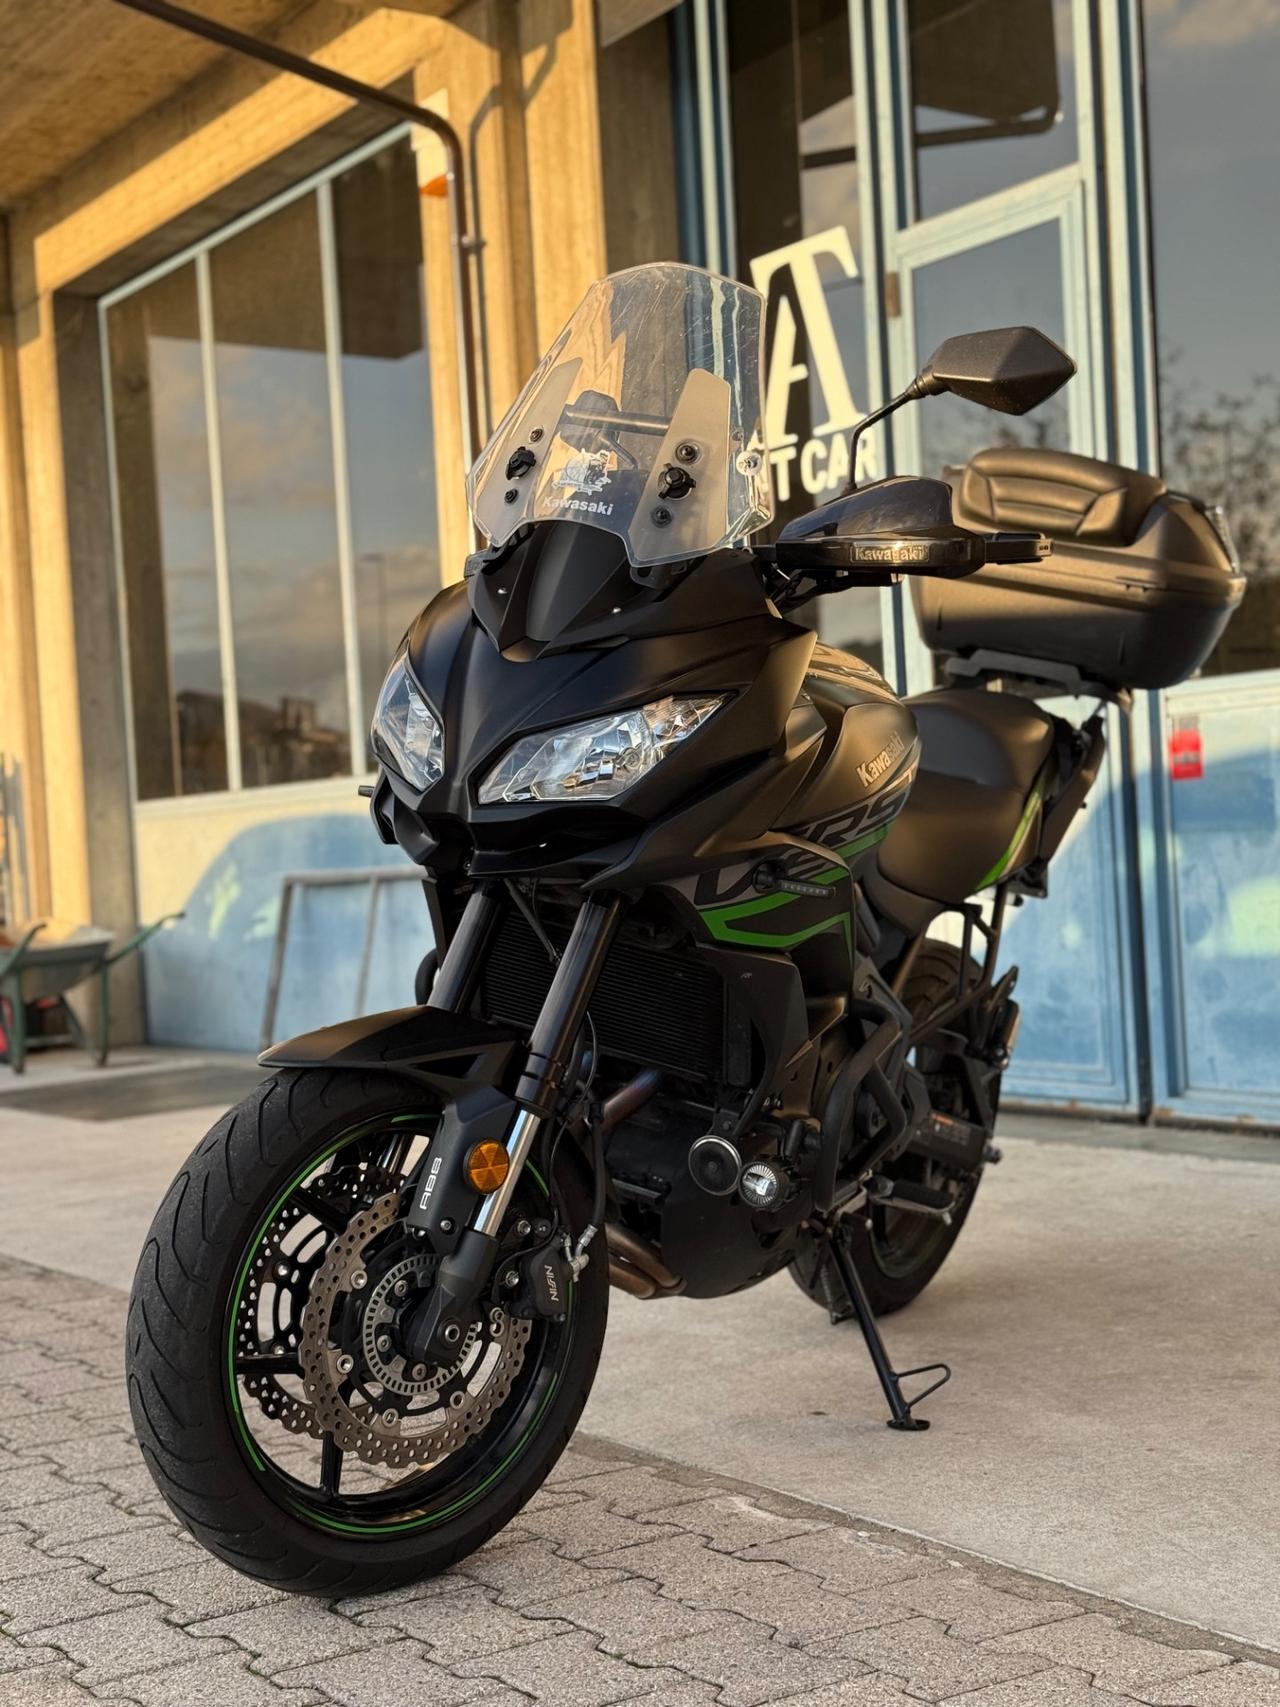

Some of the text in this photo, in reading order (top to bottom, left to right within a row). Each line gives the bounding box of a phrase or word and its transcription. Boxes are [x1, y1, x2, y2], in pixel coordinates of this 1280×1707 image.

[801, 427, 878, 493] CAR
[543, 496, 615, 516] Kawasaki
[855, 543, 923, 561] Kawasaki
[856, 731, 905, 788] Kawasaki
[420, 1157, 442, 1210] ABS
[544, 1265, 560, 1302] NISSIN
